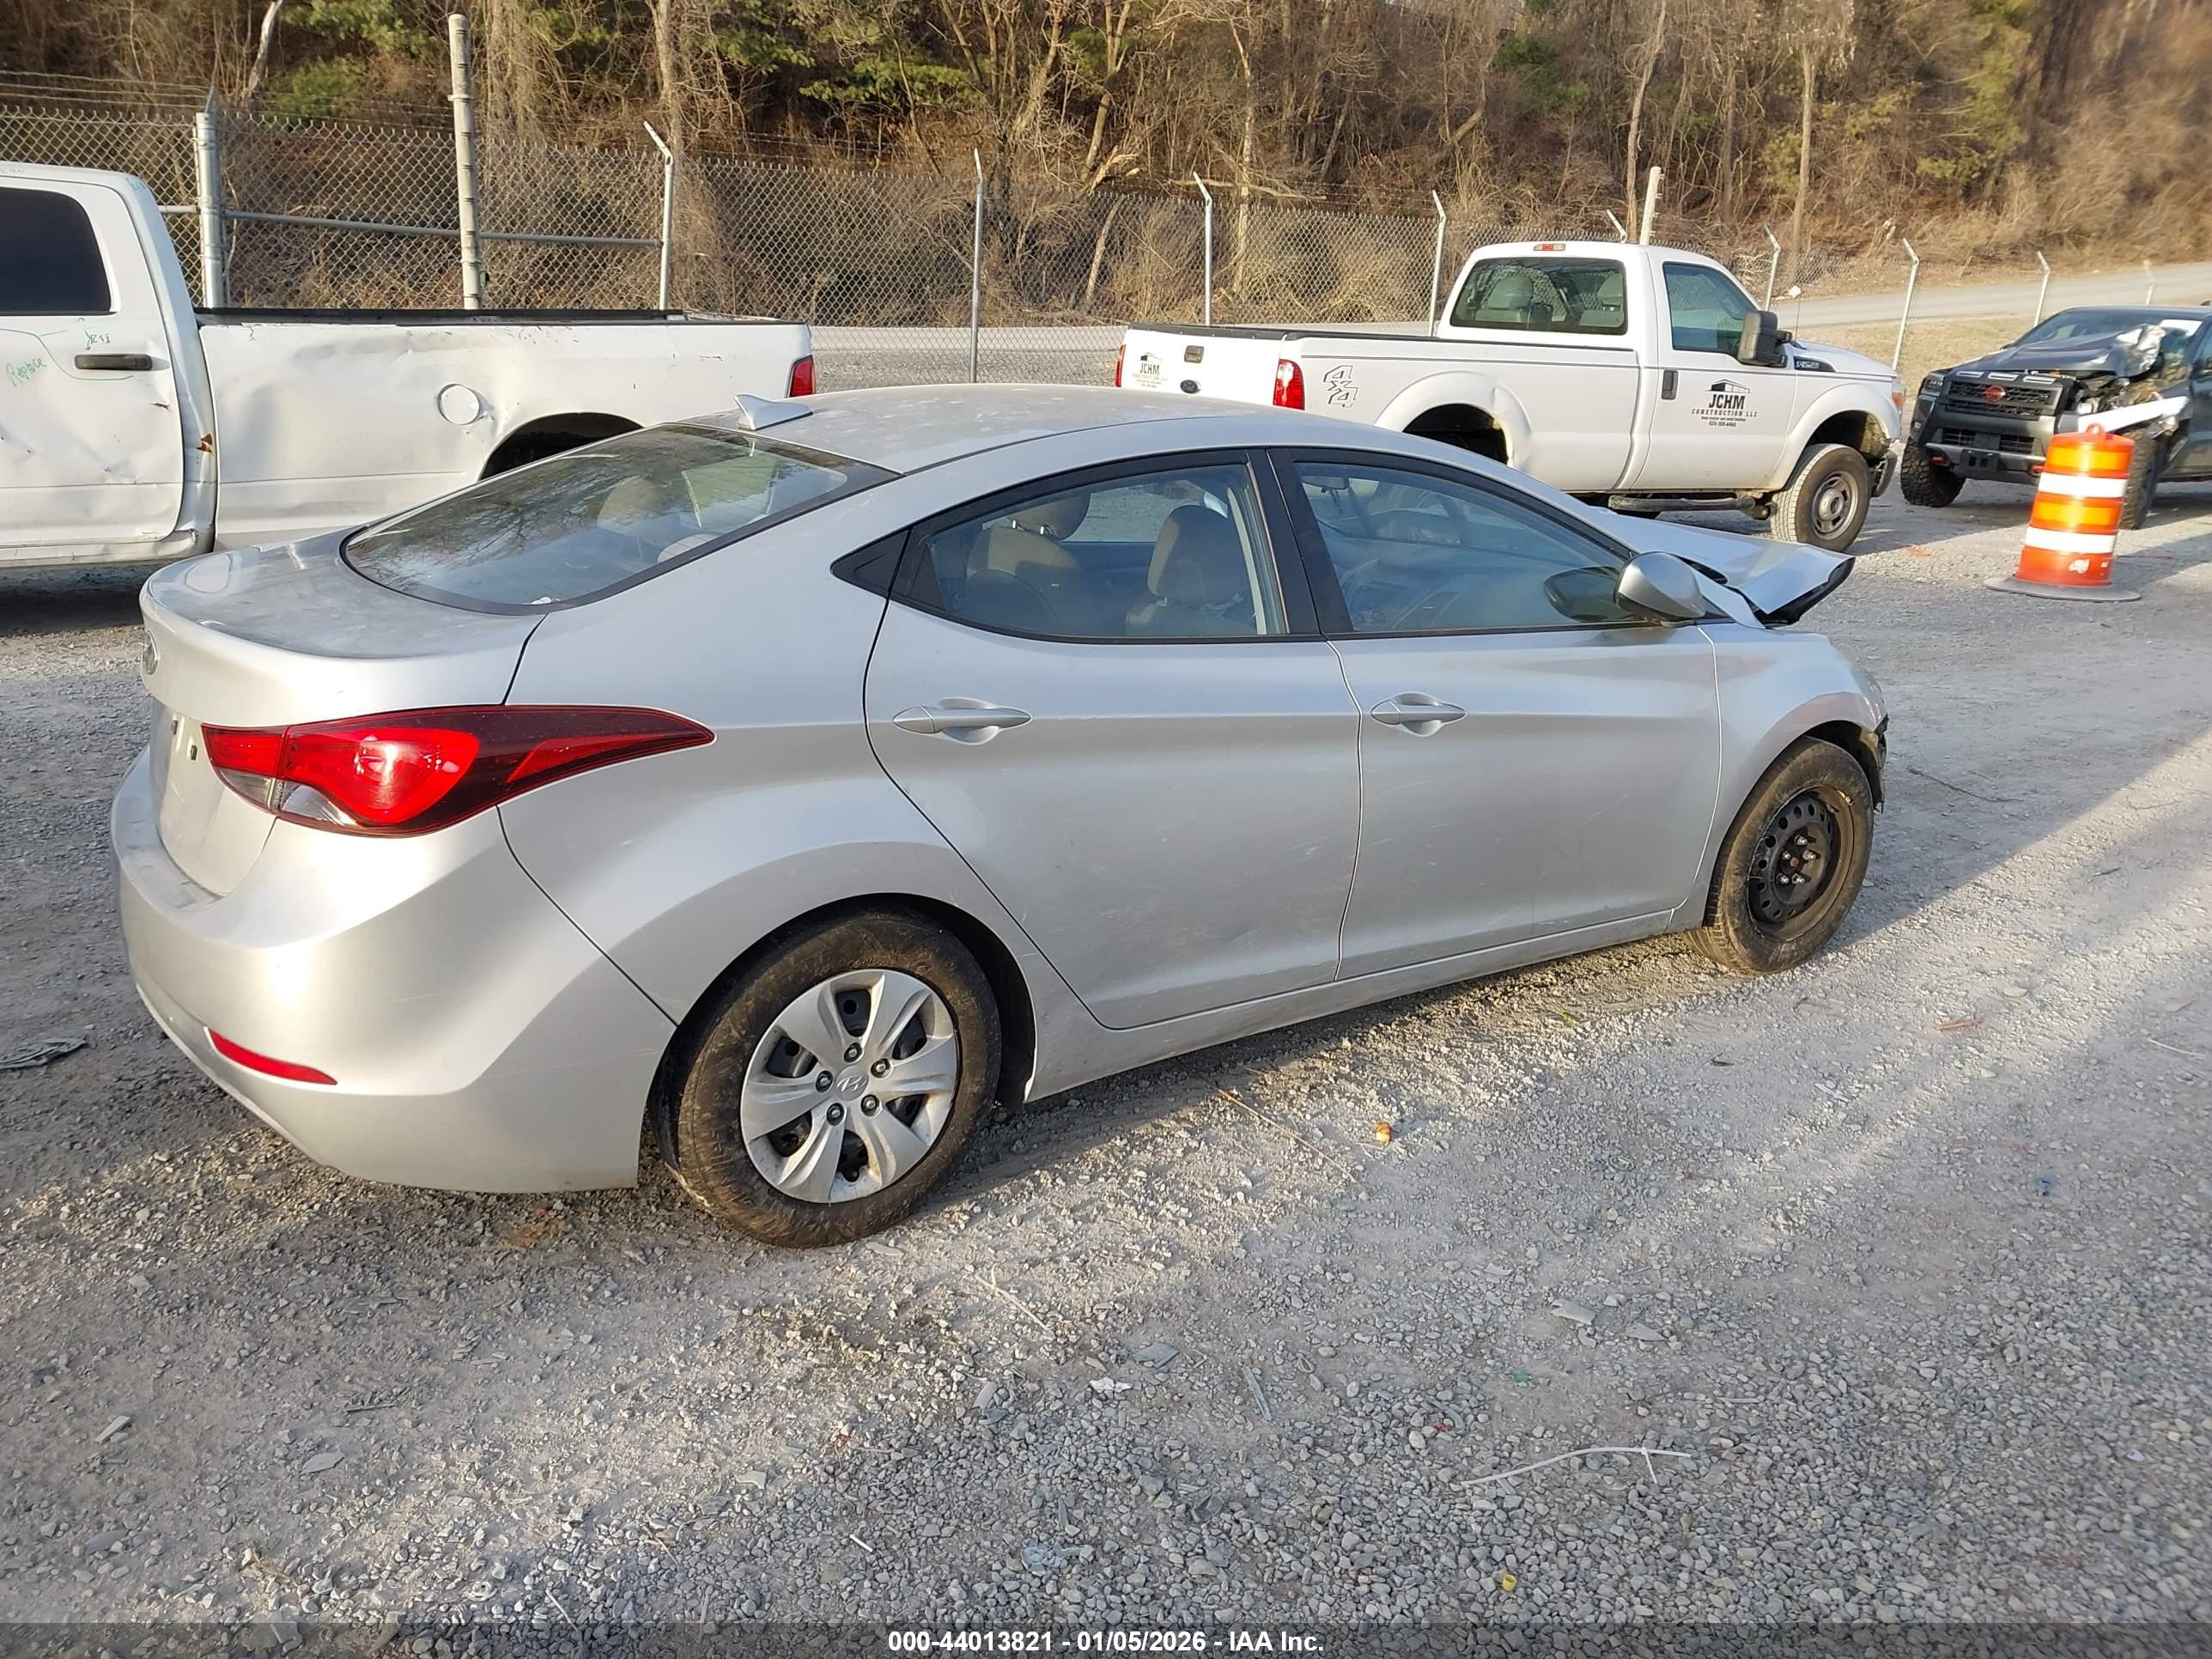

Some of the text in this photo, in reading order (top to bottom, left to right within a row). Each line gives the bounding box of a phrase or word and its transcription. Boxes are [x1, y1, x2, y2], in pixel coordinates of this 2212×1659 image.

[1139, 362, 1160, 375] JCHM
[1708, 393, 1746, 410] JCHM
[1692, 408, 1743, 417] CONSTRUCTION
